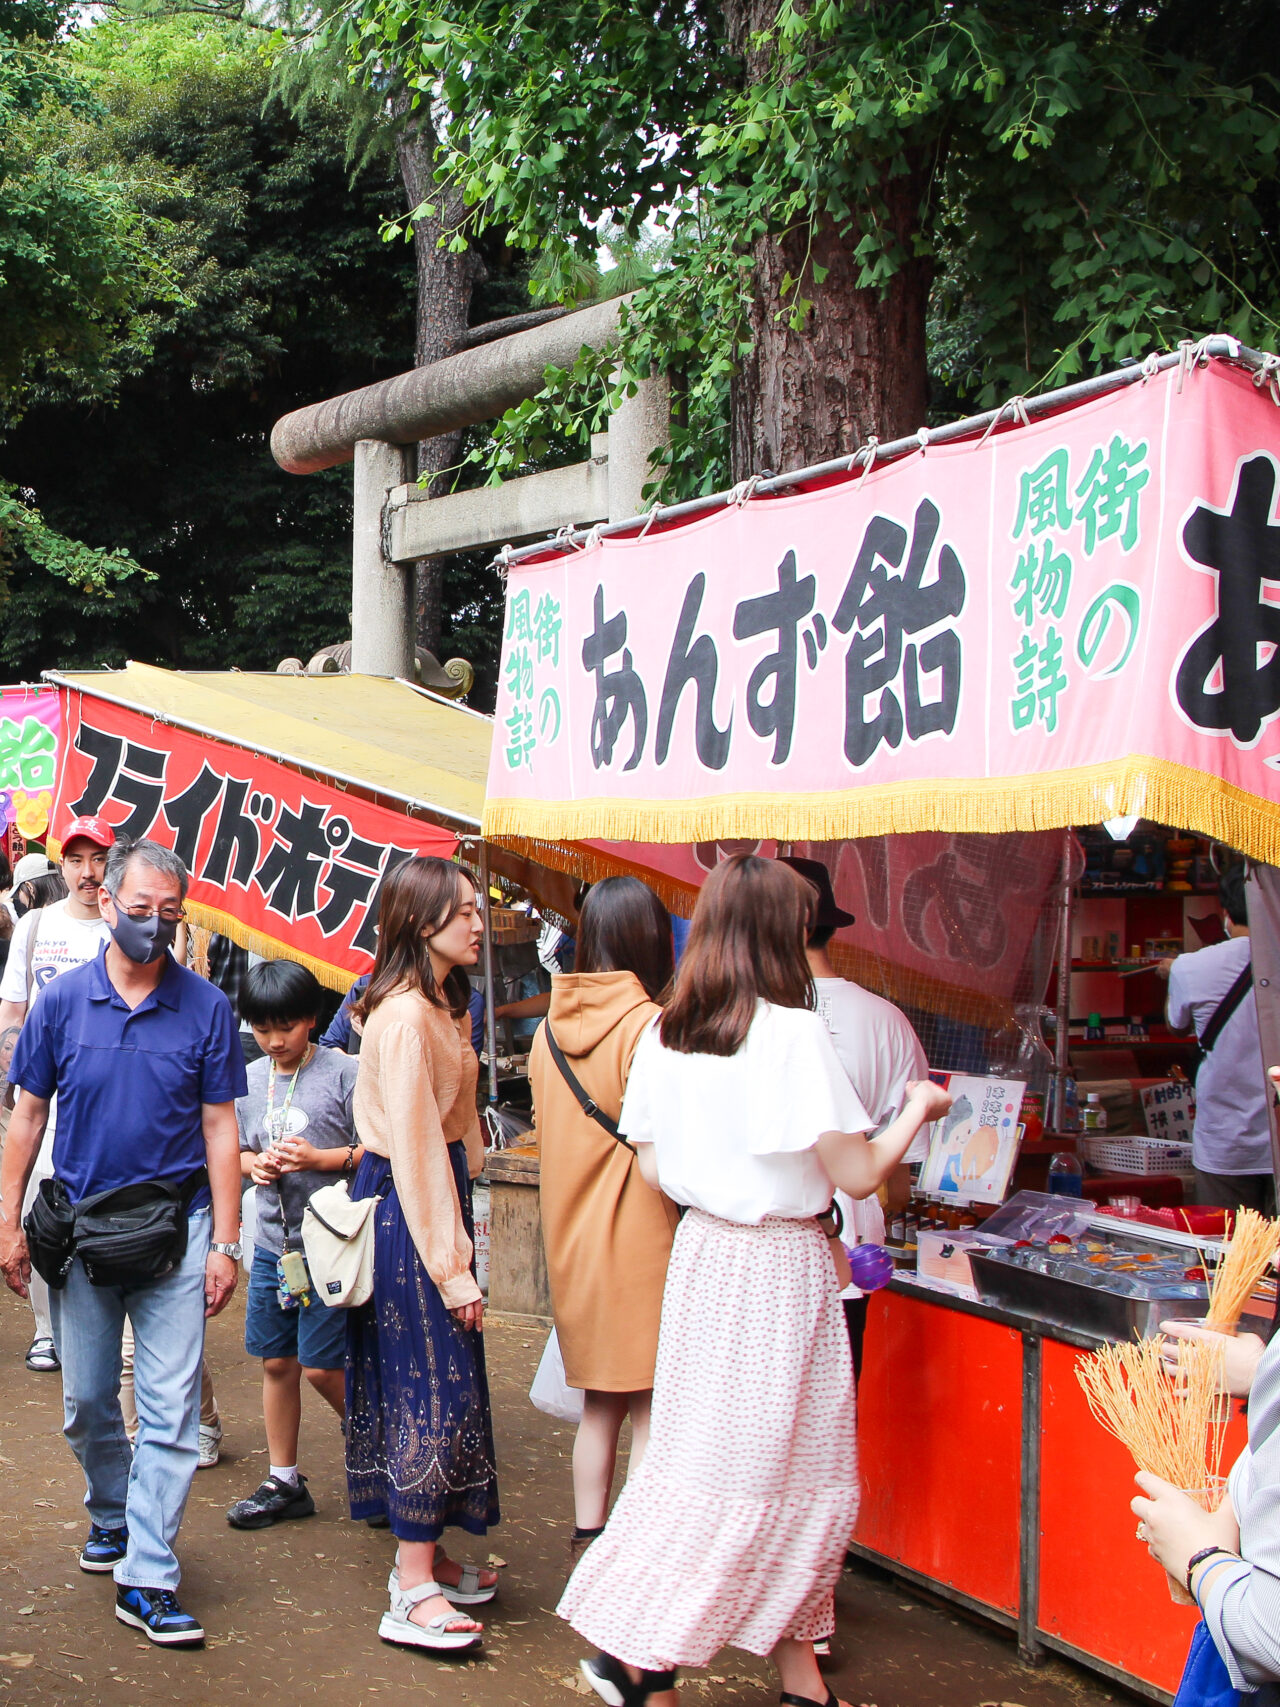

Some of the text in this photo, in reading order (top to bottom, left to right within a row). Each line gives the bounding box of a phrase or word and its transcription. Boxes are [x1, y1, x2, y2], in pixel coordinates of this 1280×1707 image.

[582, 498, 966, 773] あんず飴
[1011, 448, 1073, 733] 風物詩
[1075, 435, 1149, 678] 街の
[505, 588, 536, 774] 風物詩
[534, 591, 562, 745] 街の
[32, 948, 72, 956] akult
[33, 956, 92, 967] wallows
[34, 939, 68, 949] okyo
